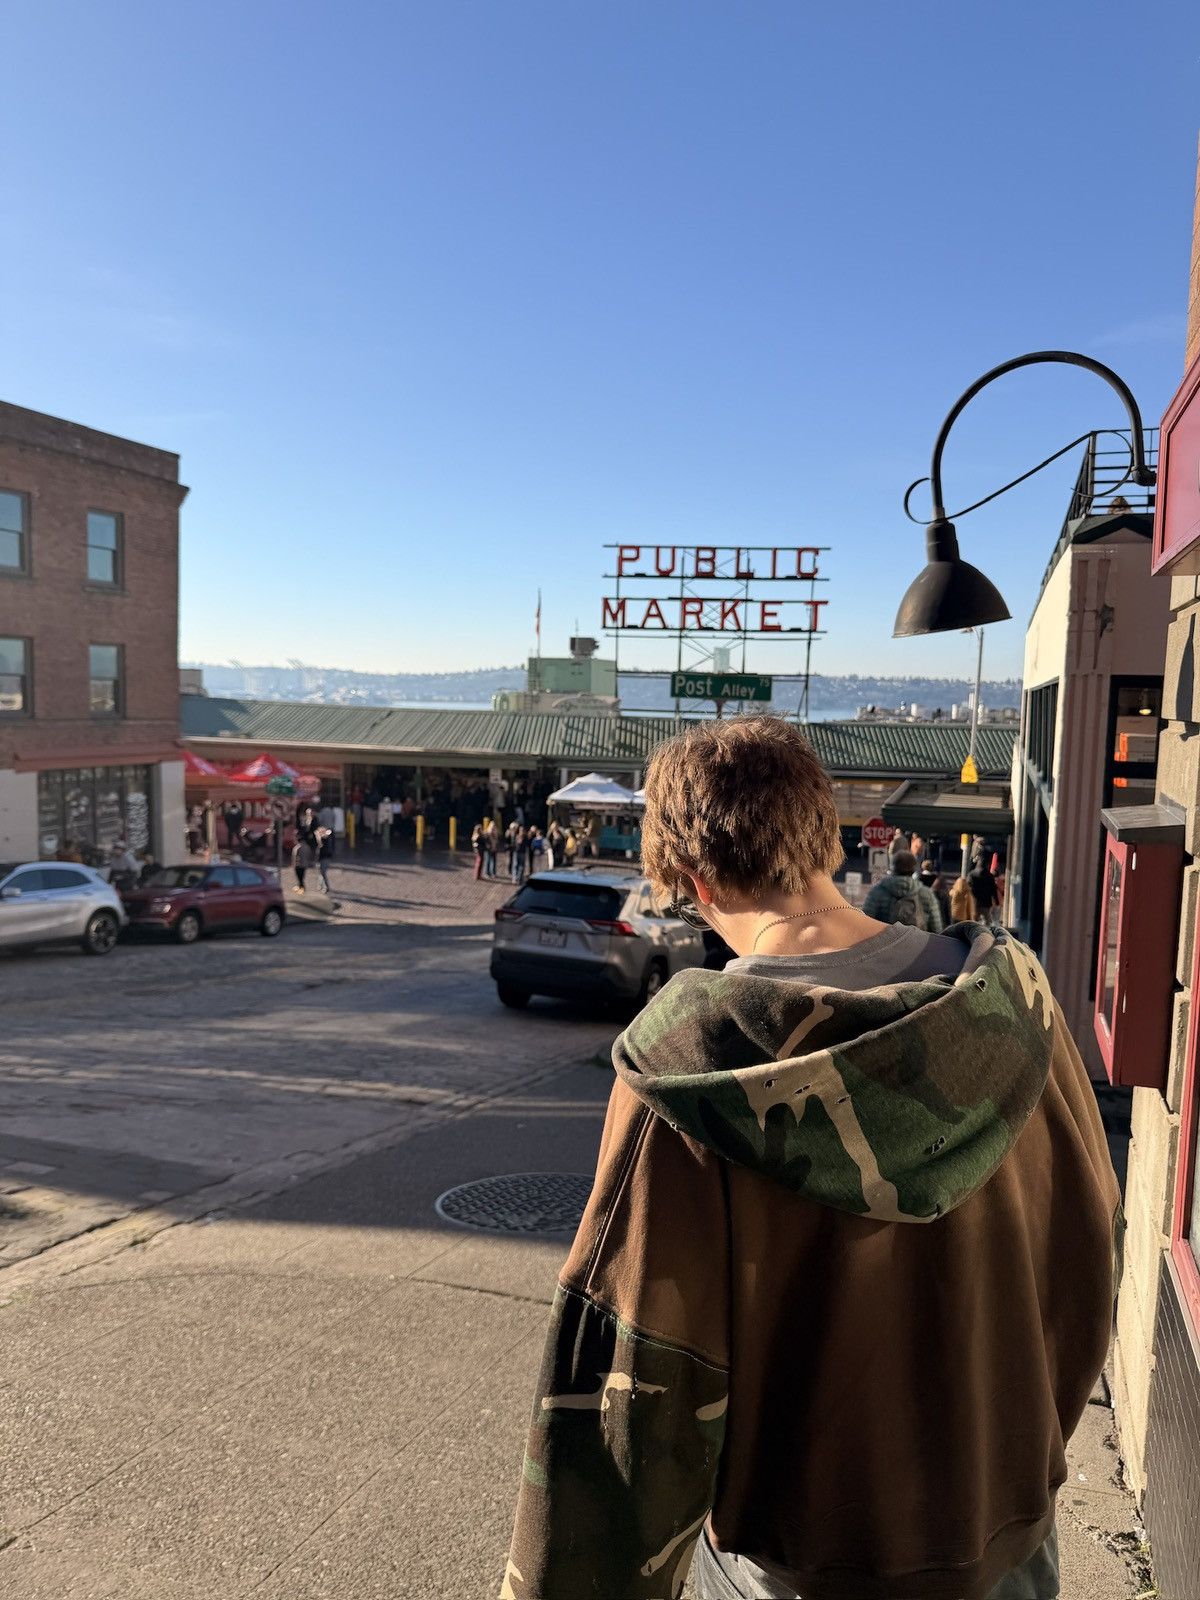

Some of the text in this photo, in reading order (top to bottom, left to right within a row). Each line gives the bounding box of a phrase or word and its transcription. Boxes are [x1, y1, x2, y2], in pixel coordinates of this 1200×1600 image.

[618, 545, 819, 579] PUBLIC
[602, 599, 829, 631] MARKET
[675, 675, 756, 700] Post Alley
[864, 826, 893, 840] STOP
